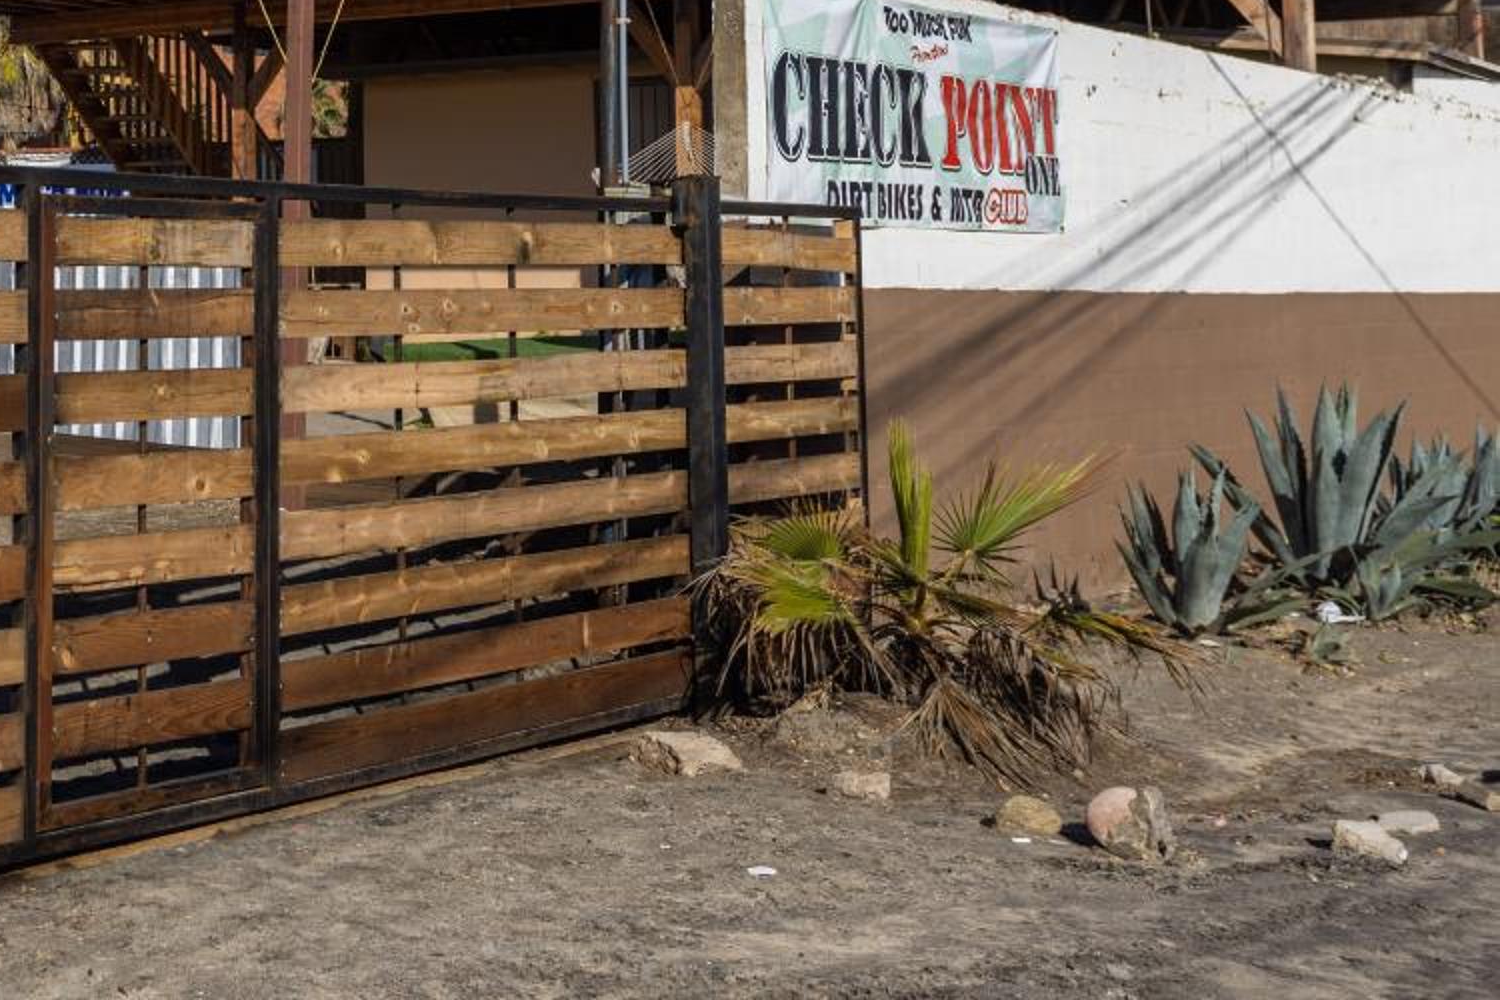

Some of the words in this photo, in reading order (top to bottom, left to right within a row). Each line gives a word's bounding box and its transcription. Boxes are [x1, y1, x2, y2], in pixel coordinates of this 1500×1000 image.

[883, 6, 909, 34] TOO
[909, 9, 949, 41] MUCH
[947, 15, 973, 42] FUN
[773, 51, 933, 168] CHECK
[939, 73, 1059, 175] POINT
[1025, 155, 1061, 197] ONE
[827, 180, 873, 219] DIRT
[878, 183, 923, 220] BIKES
[931, 186, 942, 221] &
[985, 187, 1029, 225] CLUB
